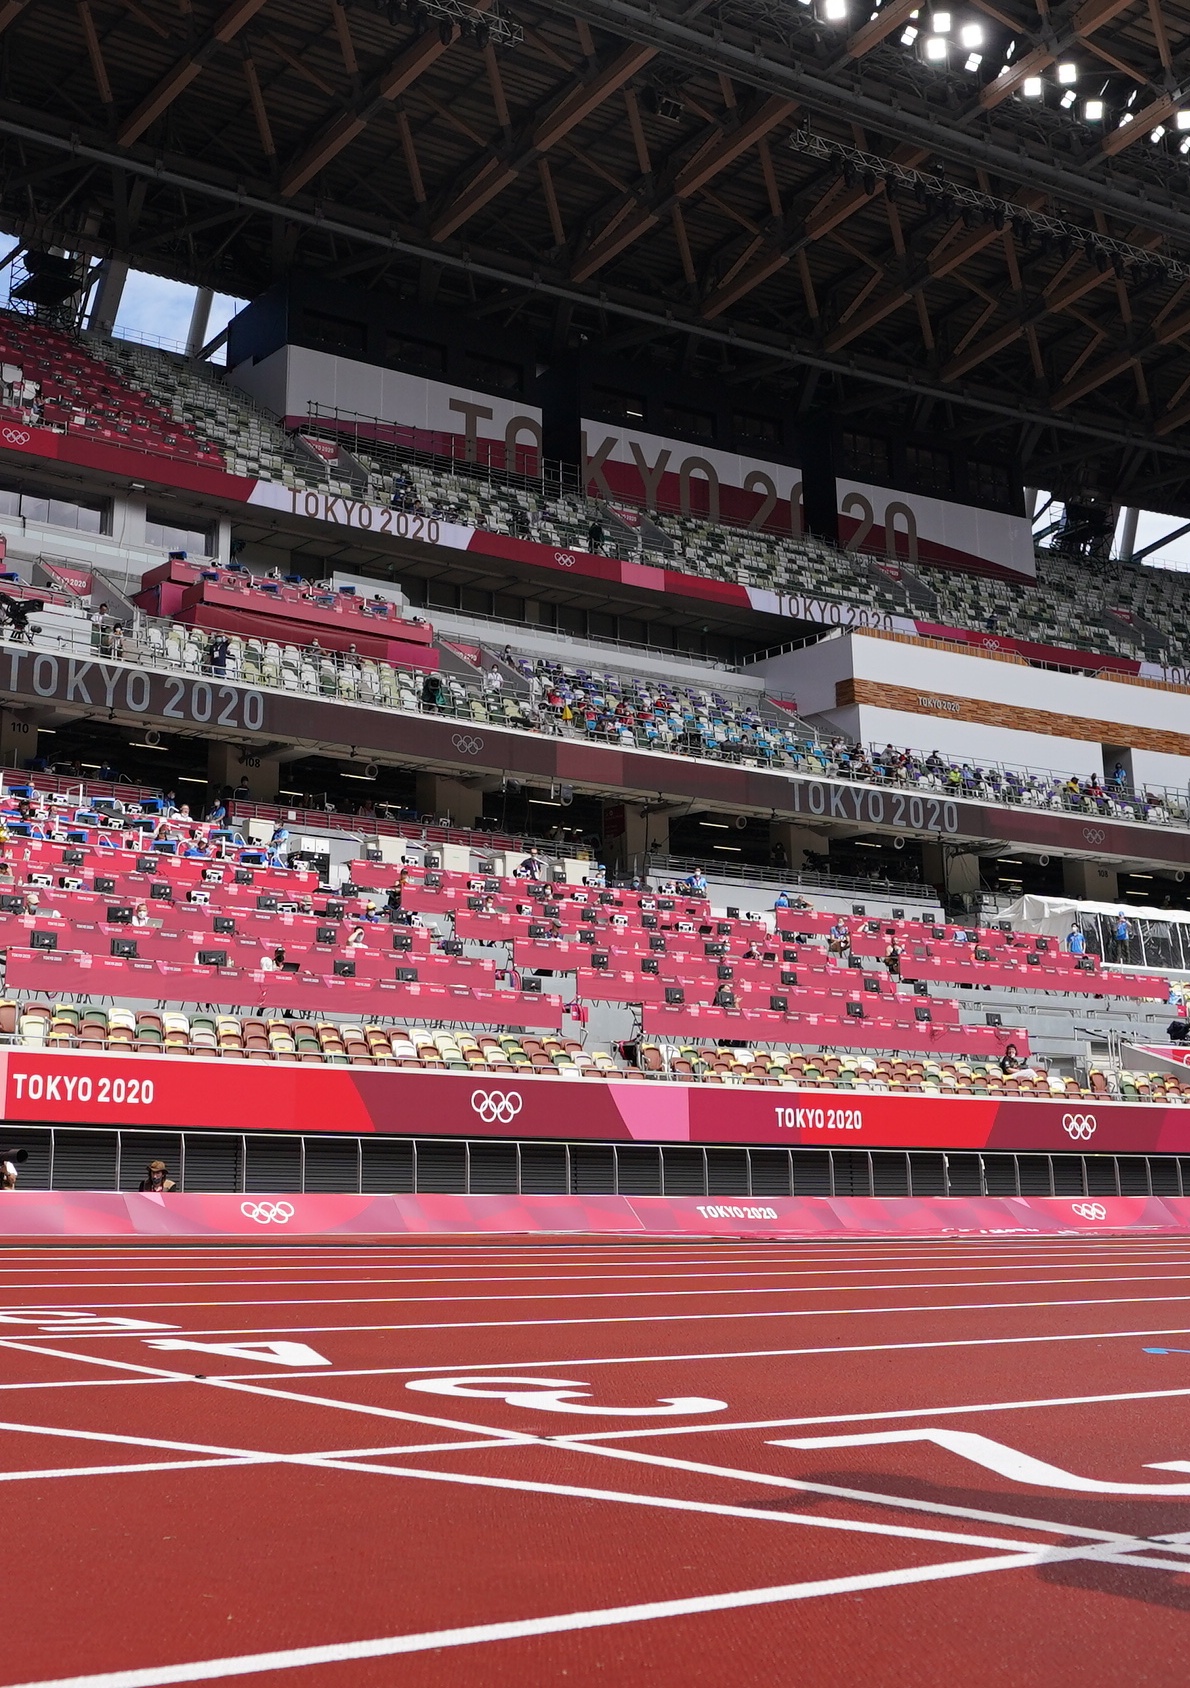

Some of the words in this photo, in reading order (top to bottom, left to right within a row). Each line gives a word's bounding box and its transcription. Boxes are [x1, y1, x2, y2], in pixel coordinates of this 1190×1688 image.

[287, 487, 374, 529] TOKYO
[380, 508, 440, 545] 2020
[775, 591, 841, 625] TOKYO
[1, 647, 151, 712] TOKYO
[162, 676, 266, 731] 2020
[918, 696, 942, 709] TOKYO
[942, 700, 961, 712] 2020
[11, 722, 29, 734] 110
[245, 757, 261, 768] 108
[788, 778, 885, 823] TOKYO
[891, 794, 959, 834] 2020
[13, 1073, 92, 1103] TOKYO
[97, 1078, 155, 1105] 2020
[775, 1107, 825, 1129] TOKYO
[827, 1109, 862, 1131] 2020
[696, 1206, 743, 1219] TOKYO
[744, 1207, 778, 1220] 2020
[140, 1338, 333, 1366] 4
[405, 1377, 728, 1415] 3
